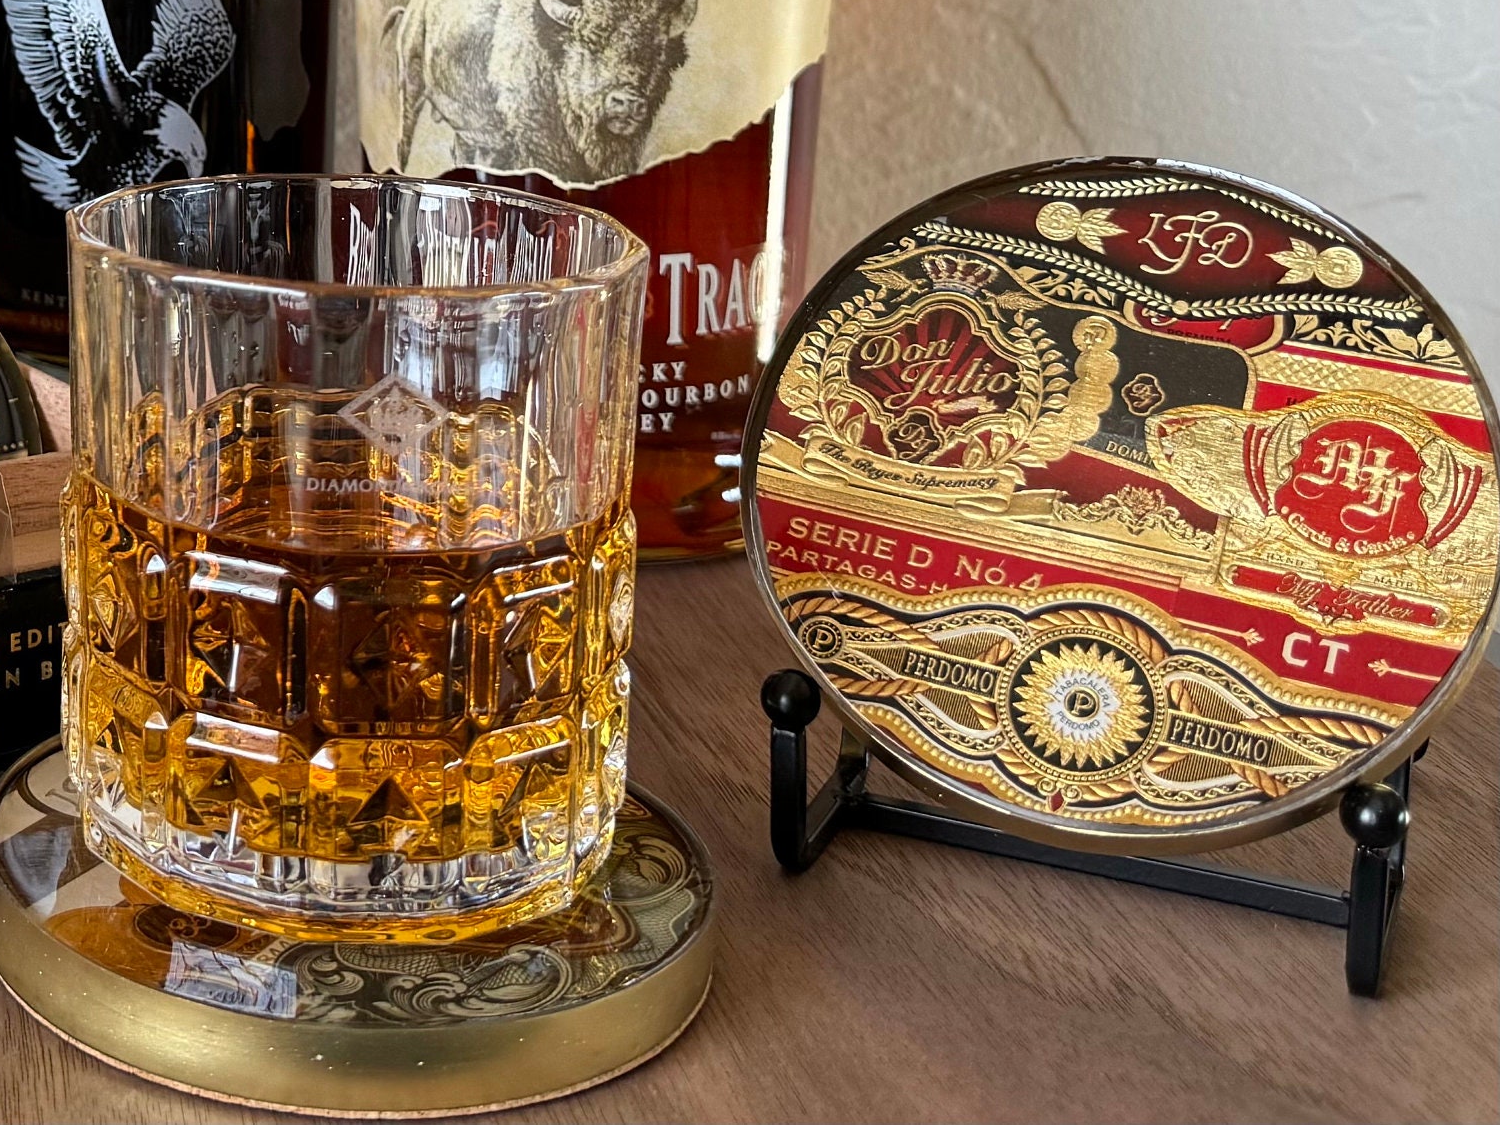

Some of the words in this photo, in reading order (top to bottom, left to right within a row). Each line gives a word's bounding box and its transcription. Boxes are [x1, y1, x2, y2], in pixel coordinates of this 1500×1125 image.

[1137, 210, 1254, 275] LFD
[21, 288, 67, 309] KENT
[659, 252, 775, 346] TRAC
[859, 333, 956, 370] Don
[641, 374, 750, 407] OURBON
[884, 358, 1018, 410] Julio
[819, 442, 851, 463] The
[905, 471, 999, 491] Supremacy
[786, 517, 899, 561] SERIE
[907, 543, 934, 569] D
[1334, 536, 1351, 554] &
[765, 540, 949, 595] PARTAGAS-H
[1276, 571, 1321, 608] My
[1332, 584, 1414, 619] Father
[811, 629, 834, 657] P
[1280, 631, 1350, 674] CT
[902, 651, 995, 694] PERDOMO
[1054, 676, 1111, 708] TABACALERA
[1056, 711, 1102, 731] PERDOMO
[1070, 691, 1094, 715] P
[1170, 718, 1271, 763] PERDOMO
